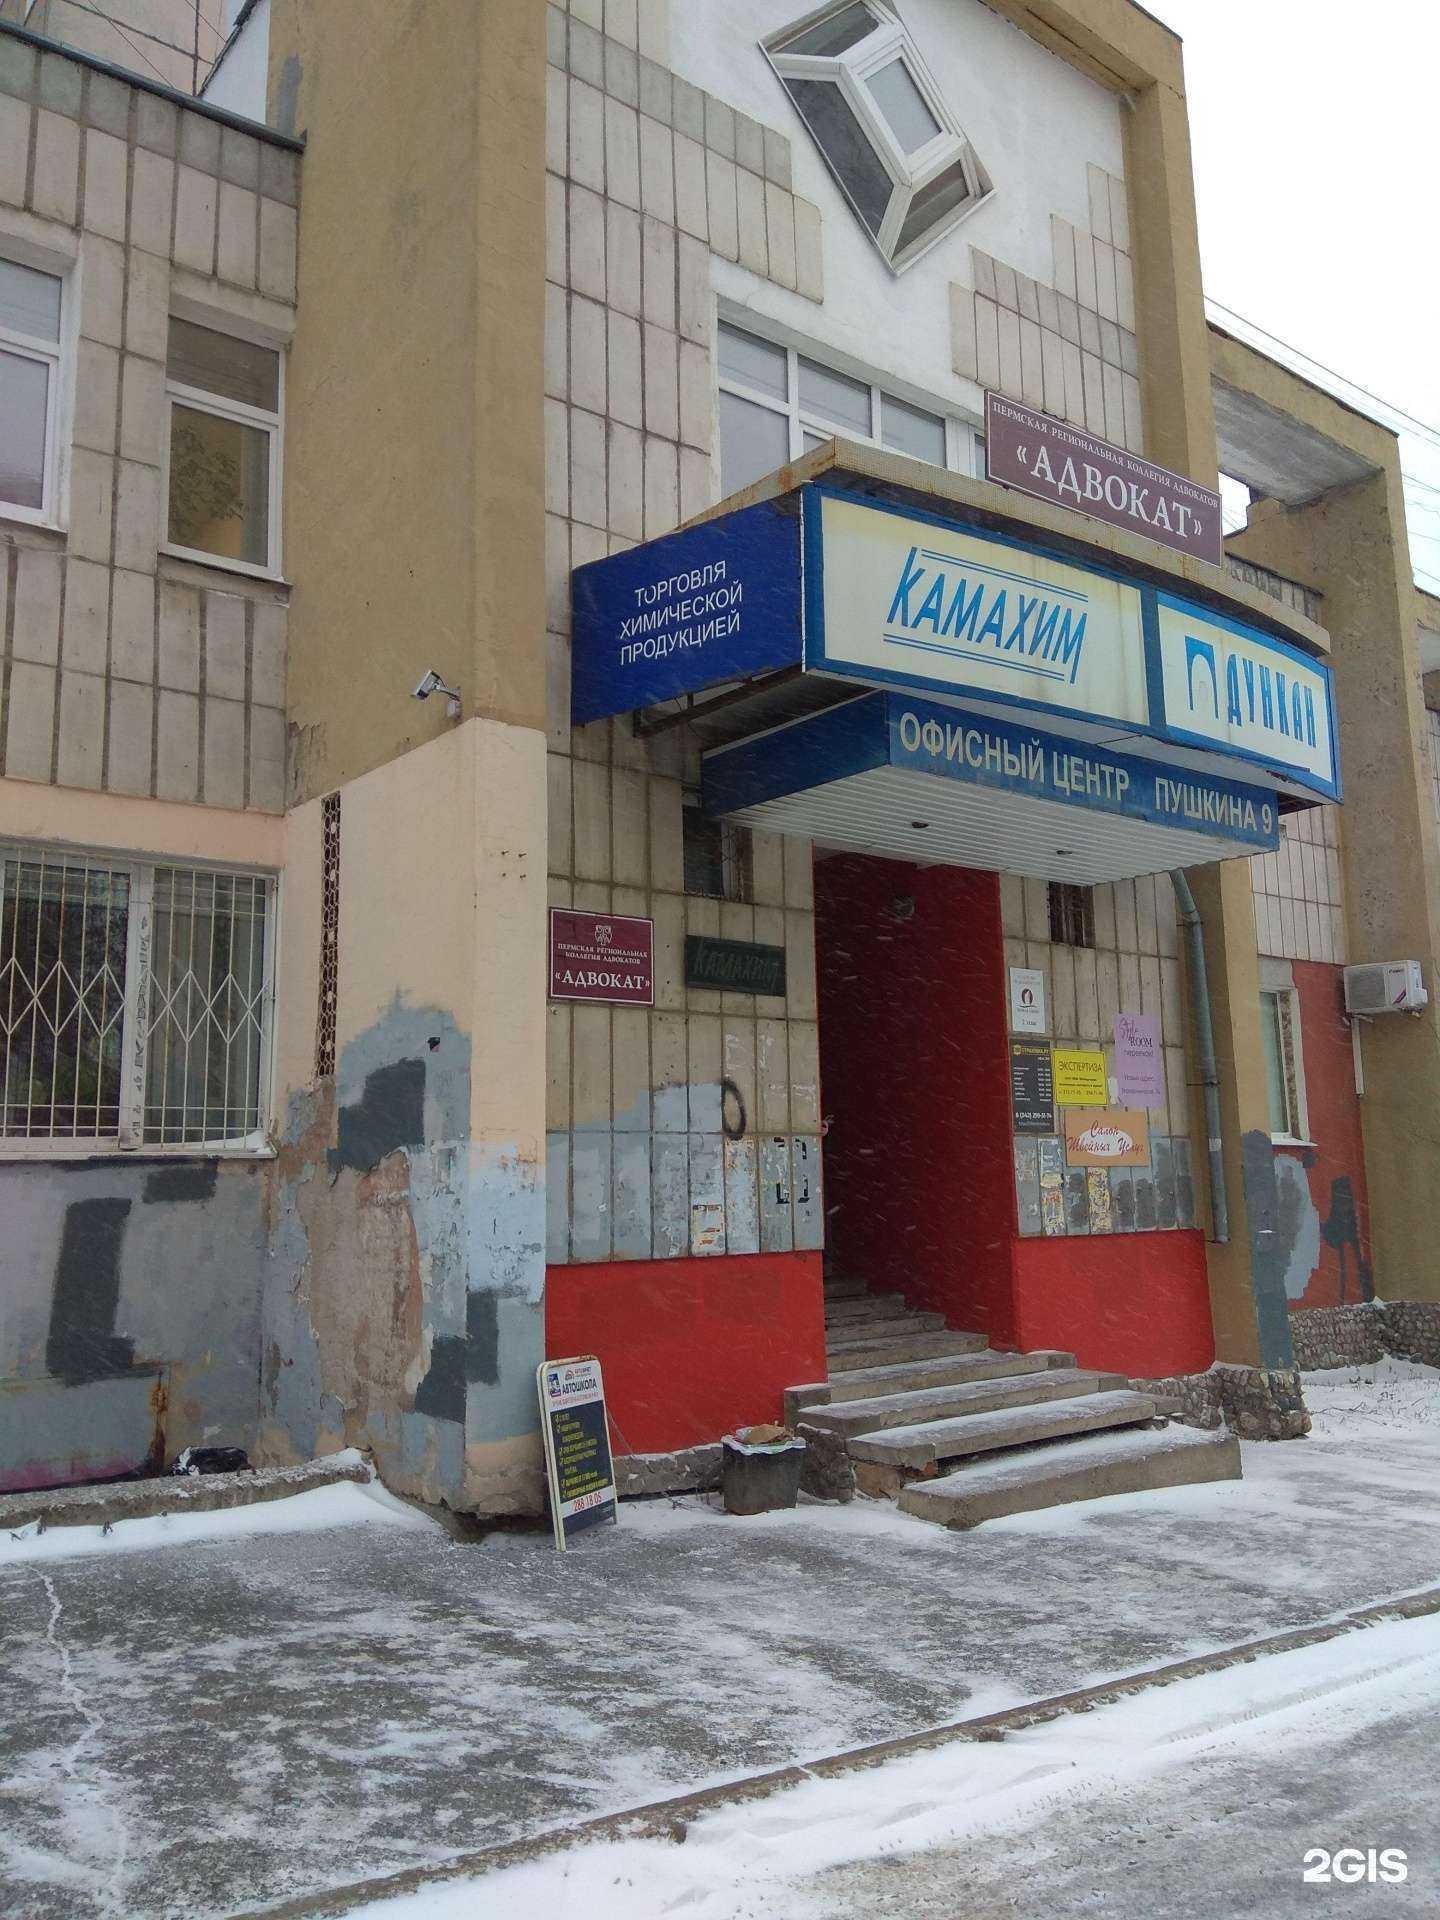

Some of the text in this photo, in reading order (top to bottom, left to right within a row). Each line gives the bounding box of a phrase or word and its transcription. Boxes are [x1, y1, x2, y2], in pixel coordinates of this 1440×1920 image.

[993, 402, 1218, 508] ПЕРМСКАЯ РЕГИОНАЛЬНАЯ КОЛЛЕГИЯ АДВОКАТОВ
[1016, 446, 1202, 538] «АДВОКАТ»
[634, 560, 726, 607] ТОРГОВЛЯ
[620, 580, 742, 639] ХИМИЧЕСКОЙ
[886, 547, 1087, 684] КАМАХИМ
[621, 609, 740, 666] ПРОДУКЦИЕЙ
[900, 712, 1273, 834] ОФИСНЫЙ ЦЕНТР ПУШКИНА 9
[557, 943, 648, 958] ПЕРМСКАЯ РЕГИОНАЛЬНАЯ
[565, 951, 641, 964] КОЛЛЕГИЯ АДВОКАТОВ
[555, 969, 651, 990] «АДВОКАТ»
[1058, 1060, 1103, 1072] ЭКСПЕРТИЗА
[1090, 1119, 1120, 1138] Салон
[562, 1378, 598, 1395] АВТОШКОЛА
